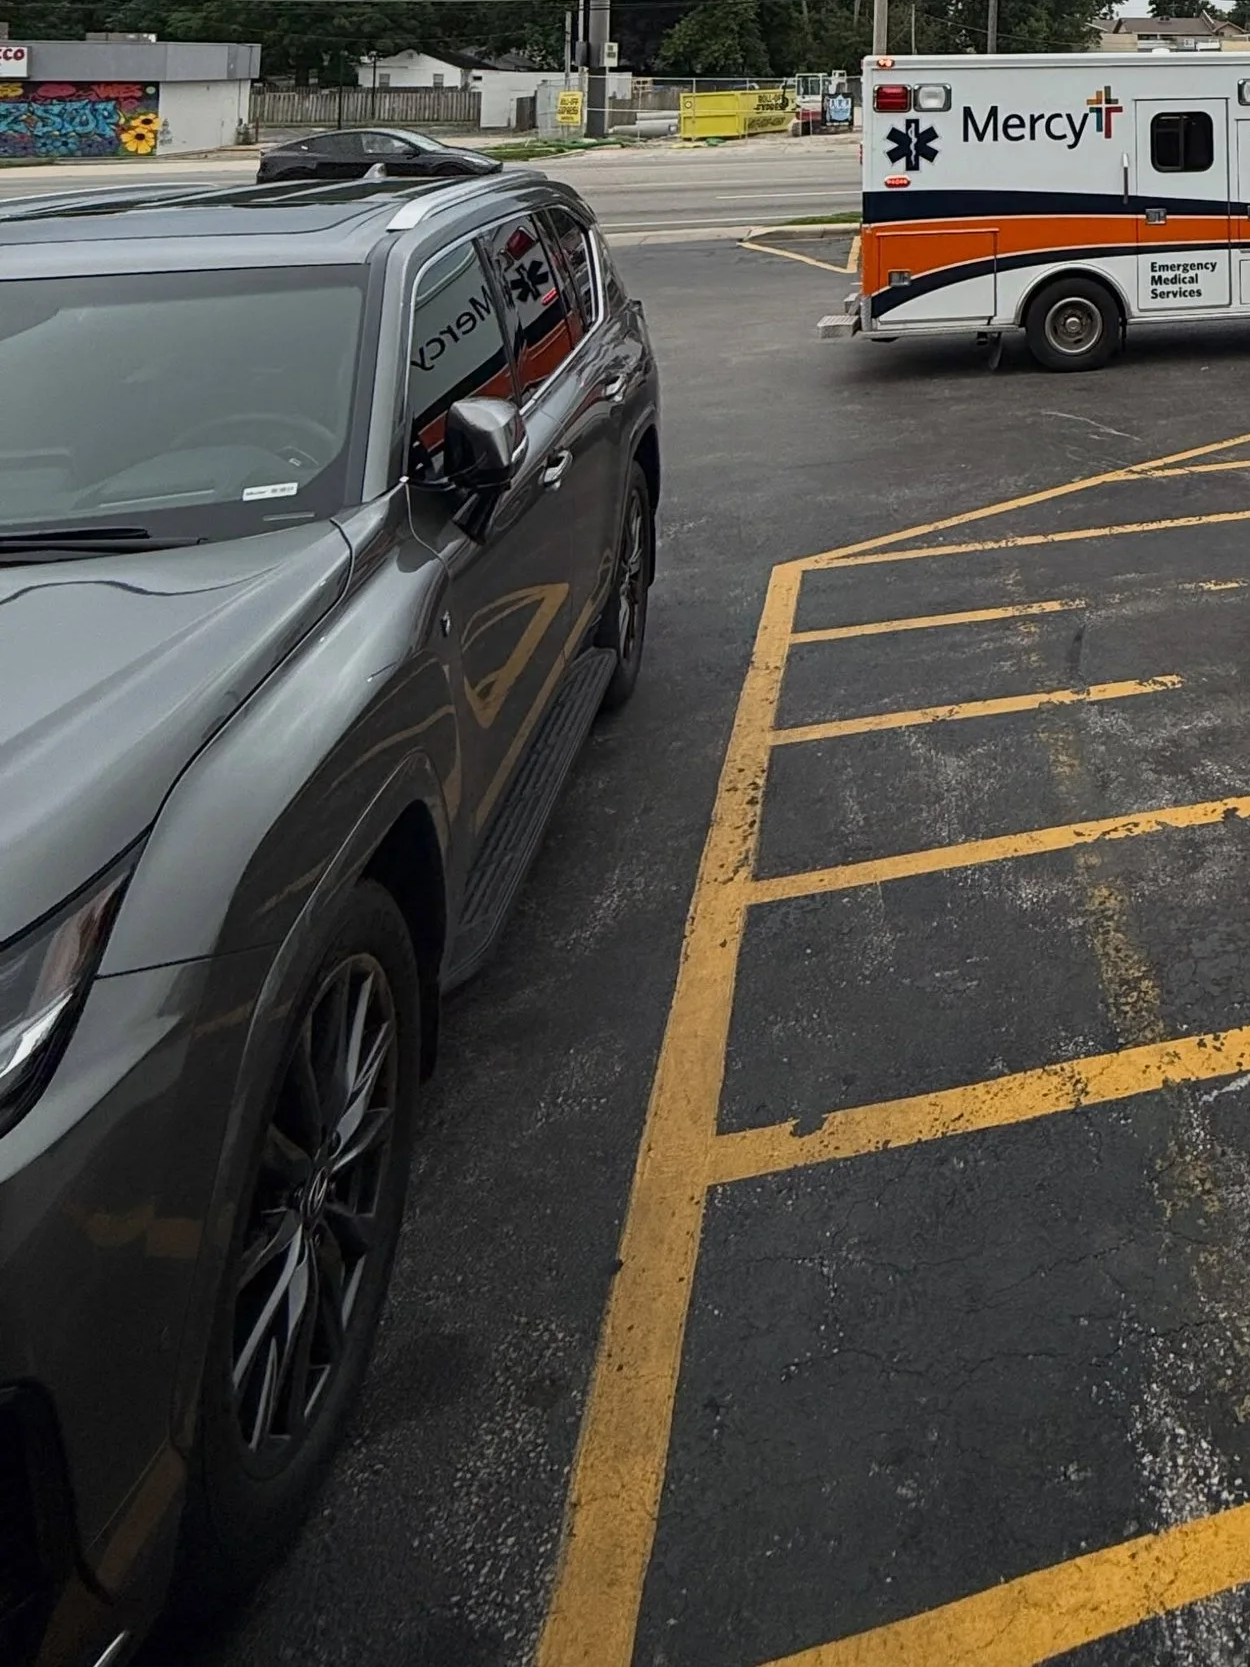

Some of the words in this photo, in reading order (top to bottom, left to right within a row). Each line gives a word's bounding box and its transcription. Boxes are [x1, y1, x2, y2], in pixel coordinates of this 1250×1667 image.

[963, 105, 1090, 150] Mercy
[1150, 260, 1218, 275] Emergency
[1150, 274, 1199, 286] Medical
[1150, 288, 1203, 300] Services
